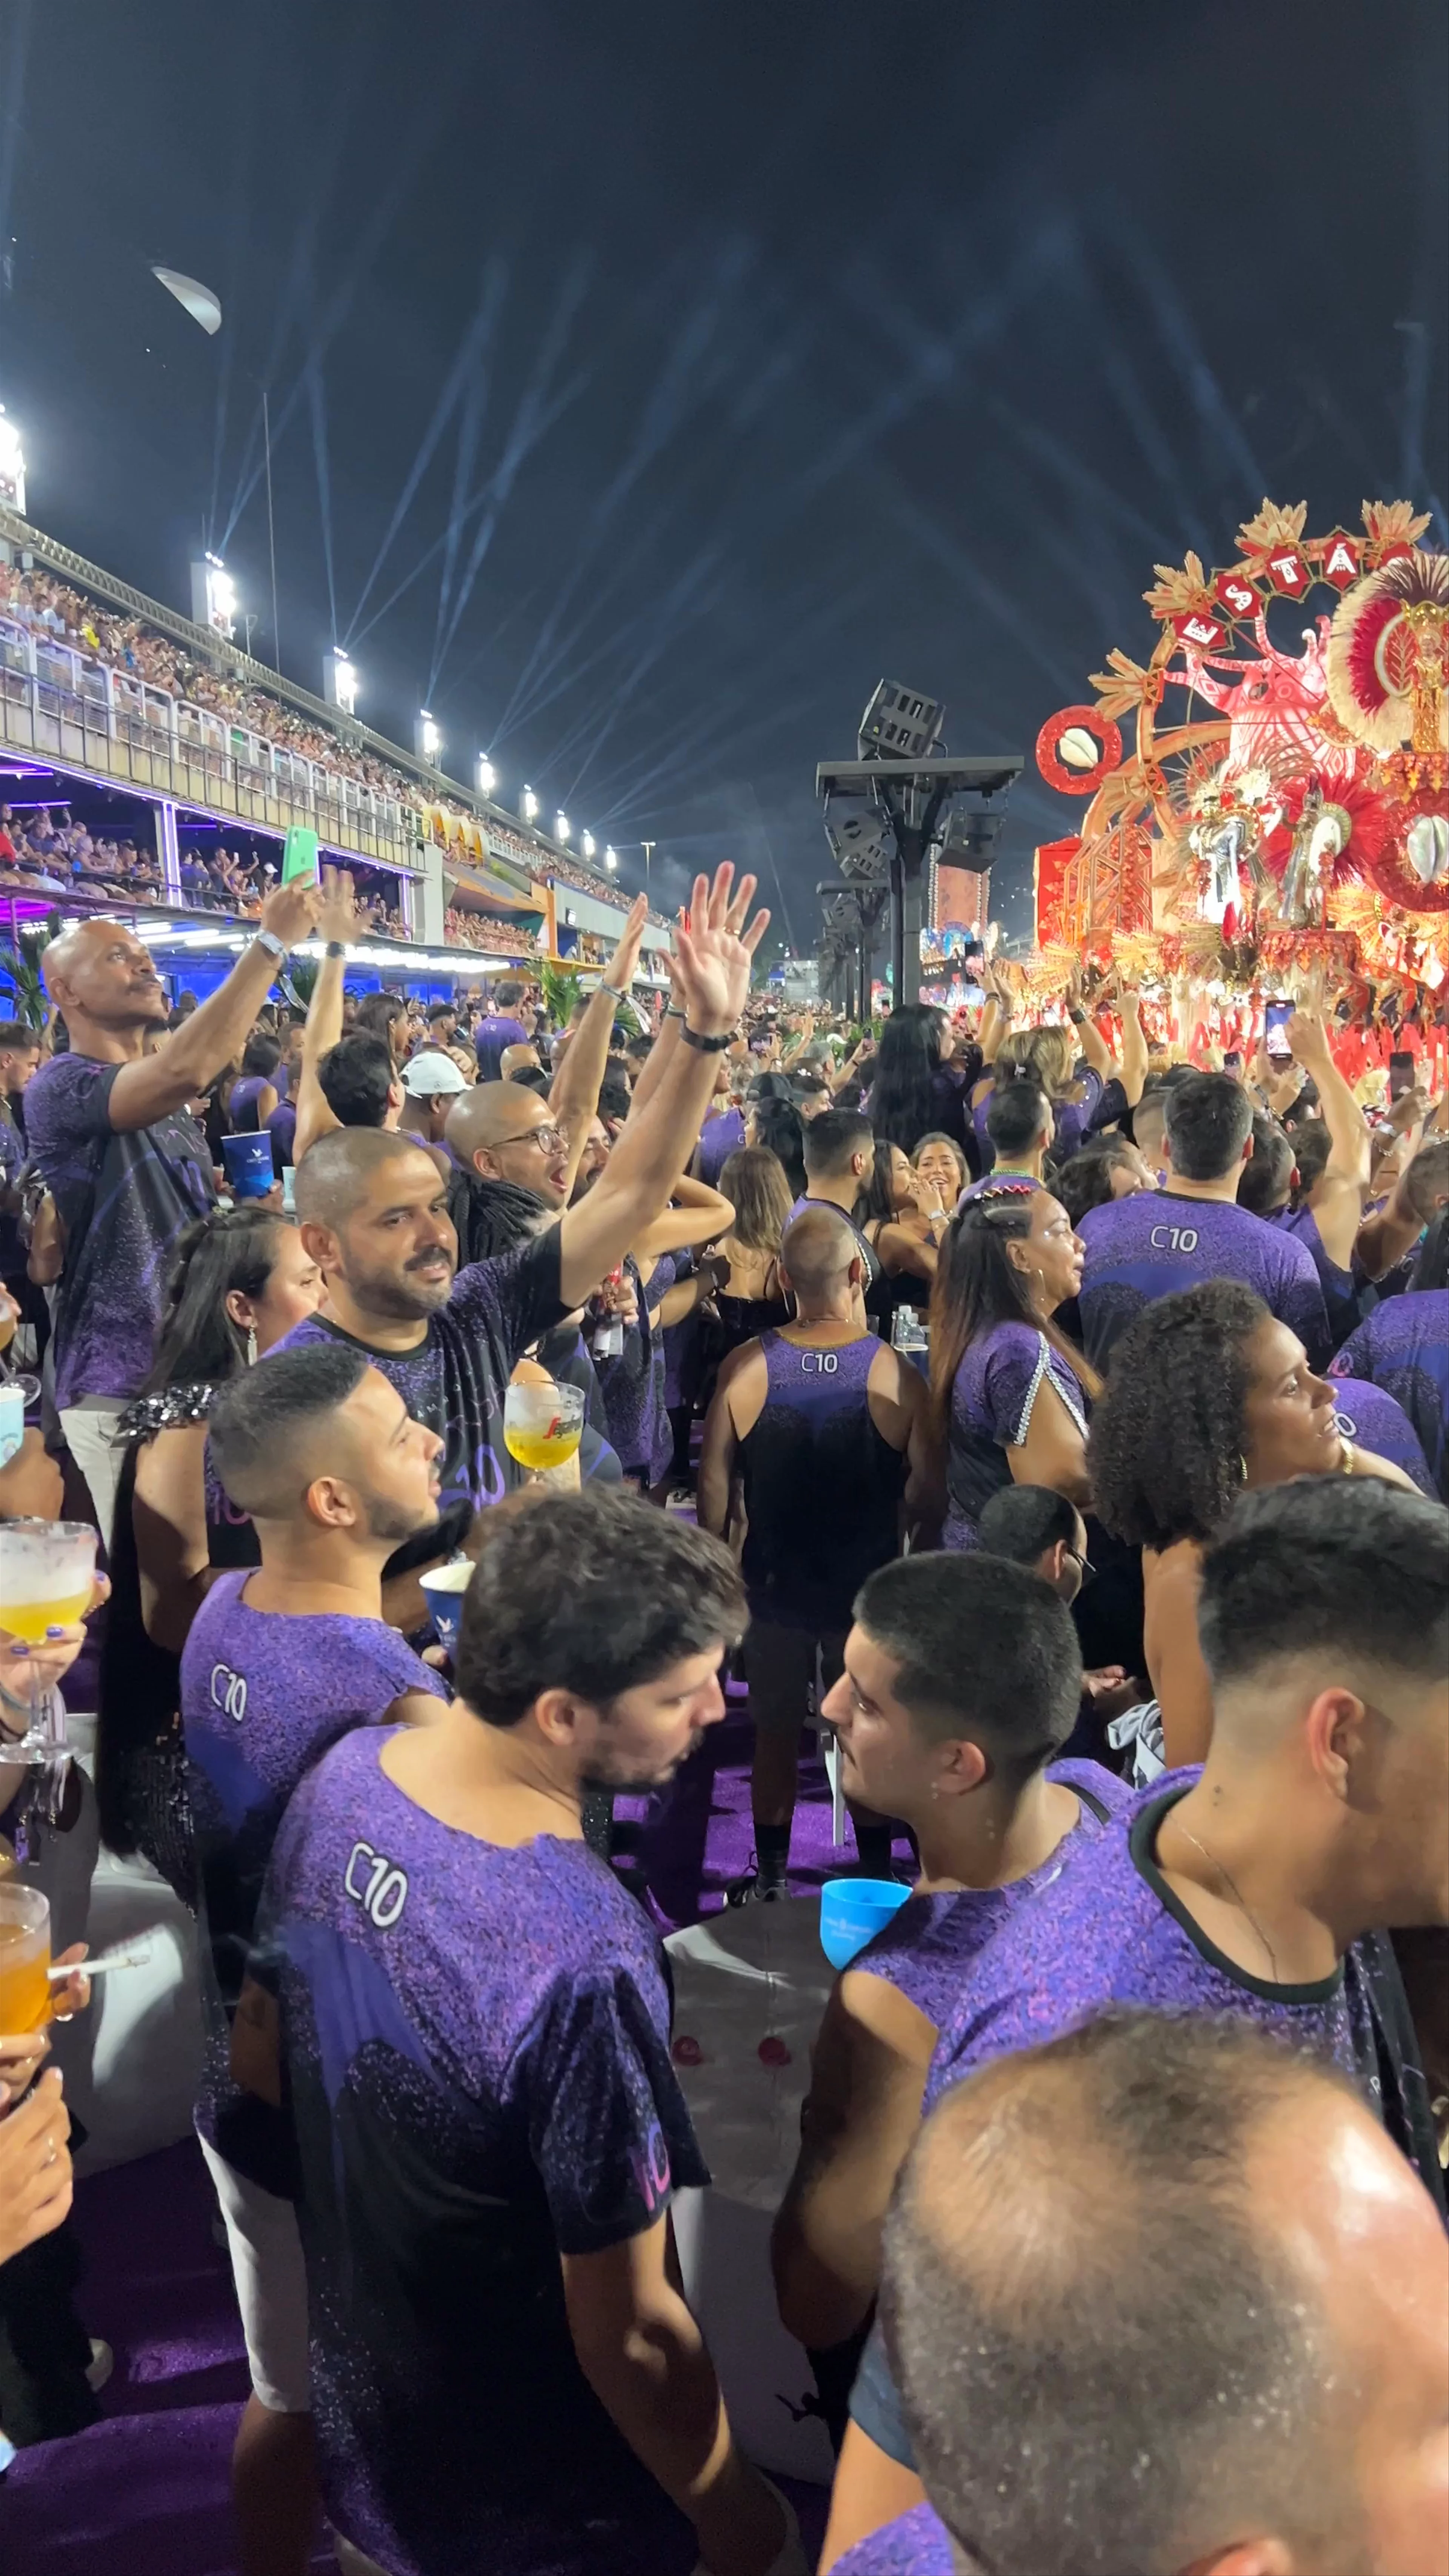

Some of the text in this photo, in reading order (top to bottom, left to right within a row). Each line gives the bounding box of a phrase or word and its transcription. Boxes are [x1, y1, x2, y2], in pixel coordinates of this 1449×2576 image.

[1151, 1226, 1198, 1252] C10
[802, 1353, 837, 1373] C10
[211, 1664, 247, 1721] C10
[345, 1842, 407, 1927] C10
